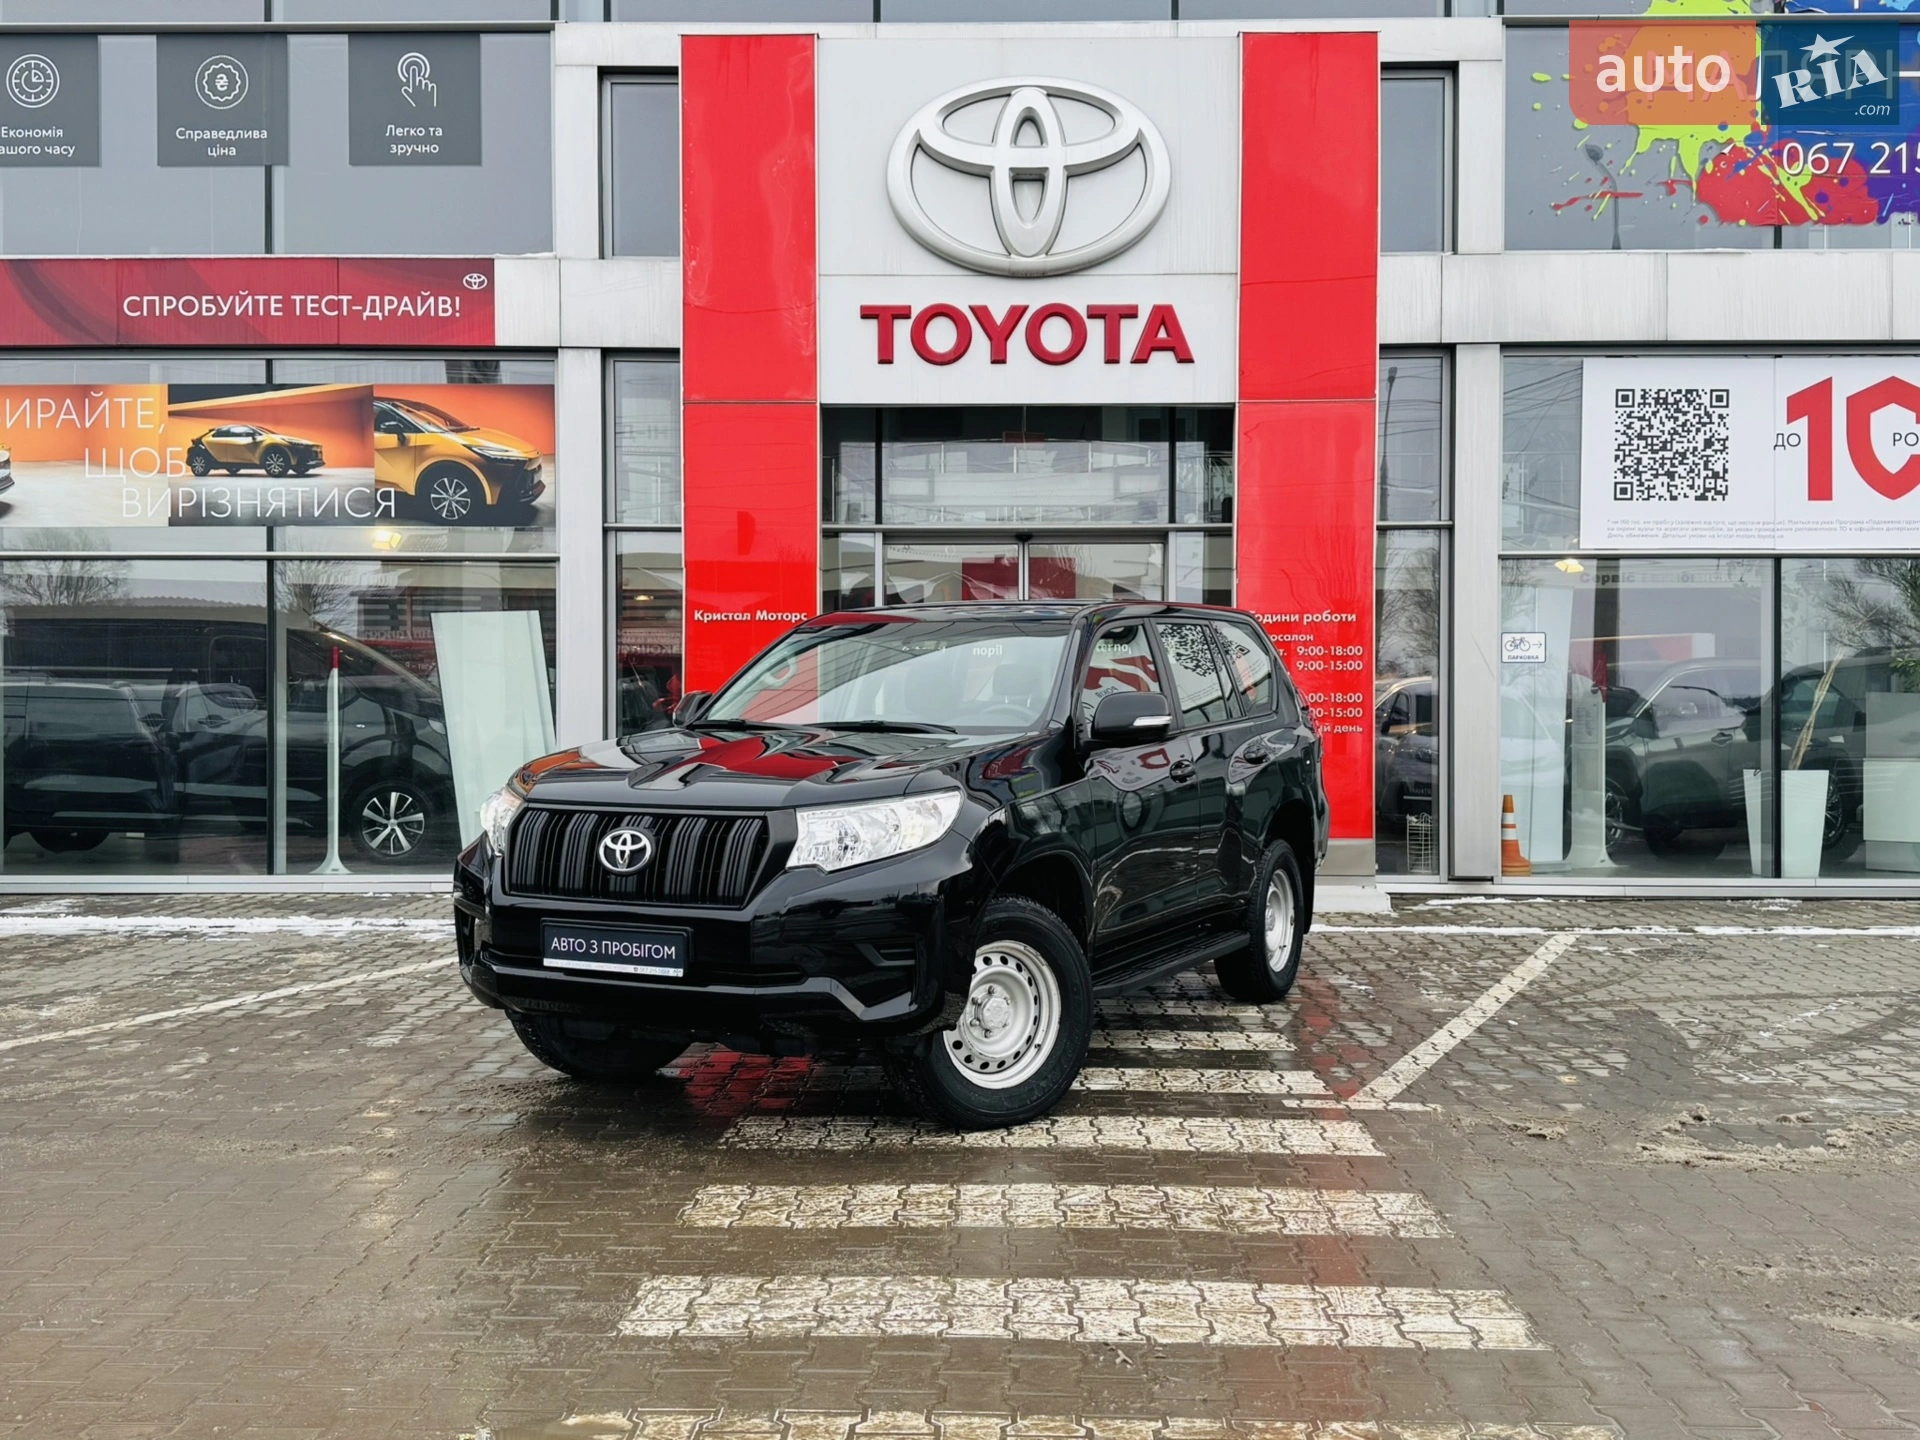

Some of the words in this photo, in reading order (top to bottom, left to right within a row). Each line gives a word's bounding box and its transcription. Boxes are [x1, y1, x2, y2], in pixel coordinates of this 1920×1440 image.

[1, 125, 64, 138] Економія
[175, 127, 268, 141] Справедлива
[385, 125, 426, 137] Легко
[428, 126, 443, 137] та
[0, 145, 41, 155] ашого
[44, 145, 76, 158] часу
[208, 143, 237, 157] ціна
[390, 143, 439, 156] зручно
[1781, 141, 1854, 175] 067
[122, 290, 283, 317] СПРОБУЙТЕ
[291, 290, 462, 320] ТЕСТ-ДРАЙВ!
[860, 302, 1195, 365] TOYOTA
[0, 391, 165, 434] ИРАЙТЕ,
[1773, 432, 1802, 451] ДО
[84, 446, 186, 484] ЩОБ
[122, 486, 396, 518] ВИРІЗНЯТИСЯ
[694, 610, 750, 623] Кристал
[755, 610, 808, 623] Моторс
[1303, 610, 1357, 625] роботи
[1296, 646, 1363, 656] 9:00-18:00
[1296, 660, 1363, 671] 9:00-15:00
[1333, 724, 1363, 734] день
[551, 937, 586, 953] АВТО
[589, 940, 598, 954] З
[602, 940, 676, 960] ПРОБІГОМ
